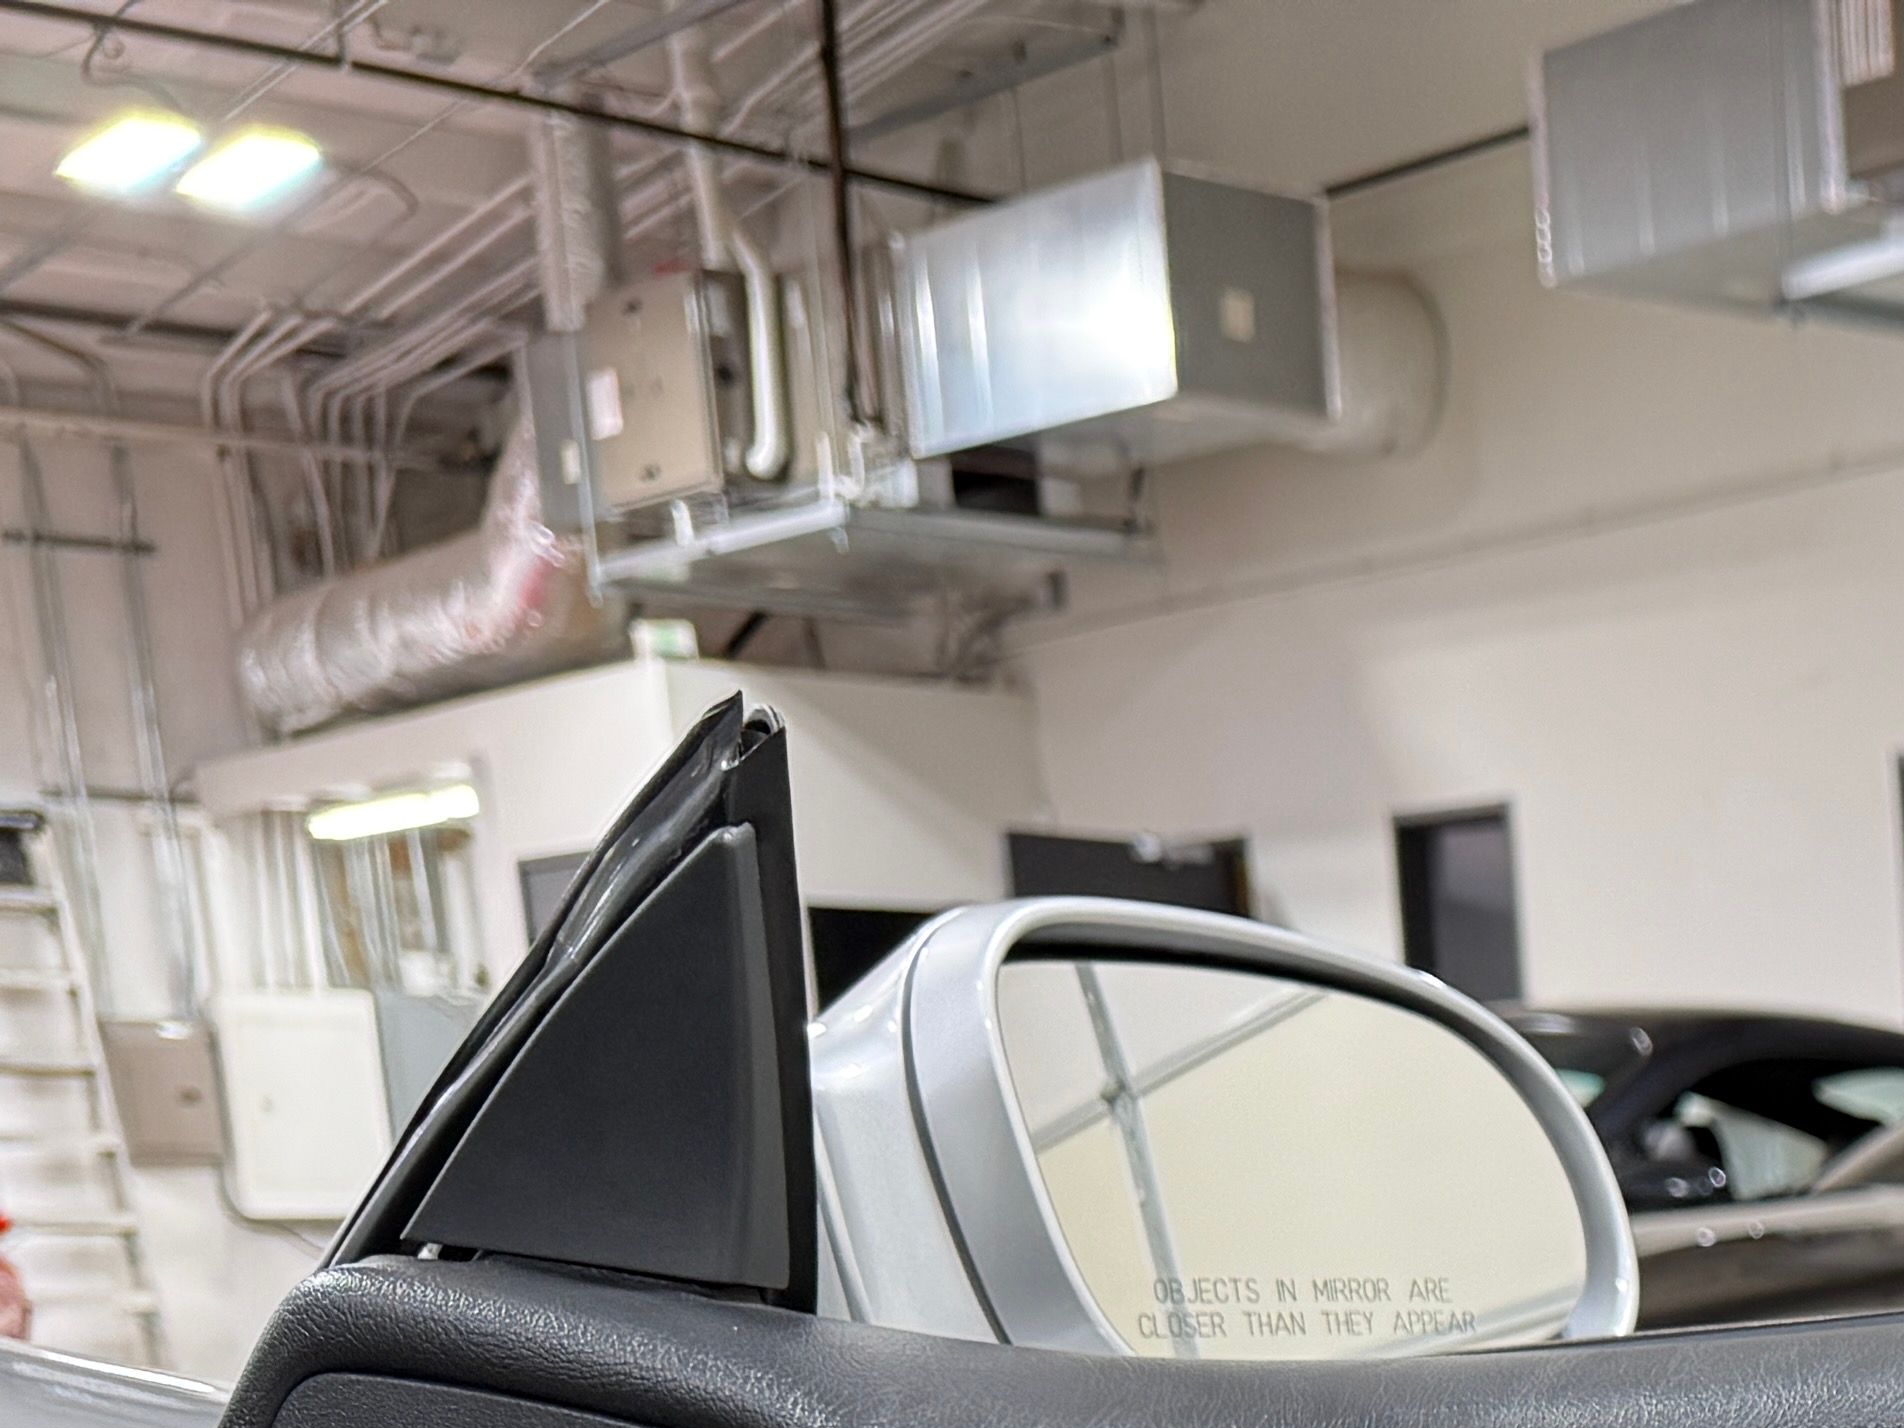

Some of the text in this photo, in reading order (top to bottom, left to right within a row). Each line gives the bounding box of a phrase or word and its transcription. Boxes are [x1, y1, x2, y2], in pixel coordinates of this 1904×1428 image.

[1153, 1277, 1453, 1304] OBJECTS IN MIRROR ARE
[1138, 1310, 1478, 1340] CLOSER THAN THEY APPEAR
